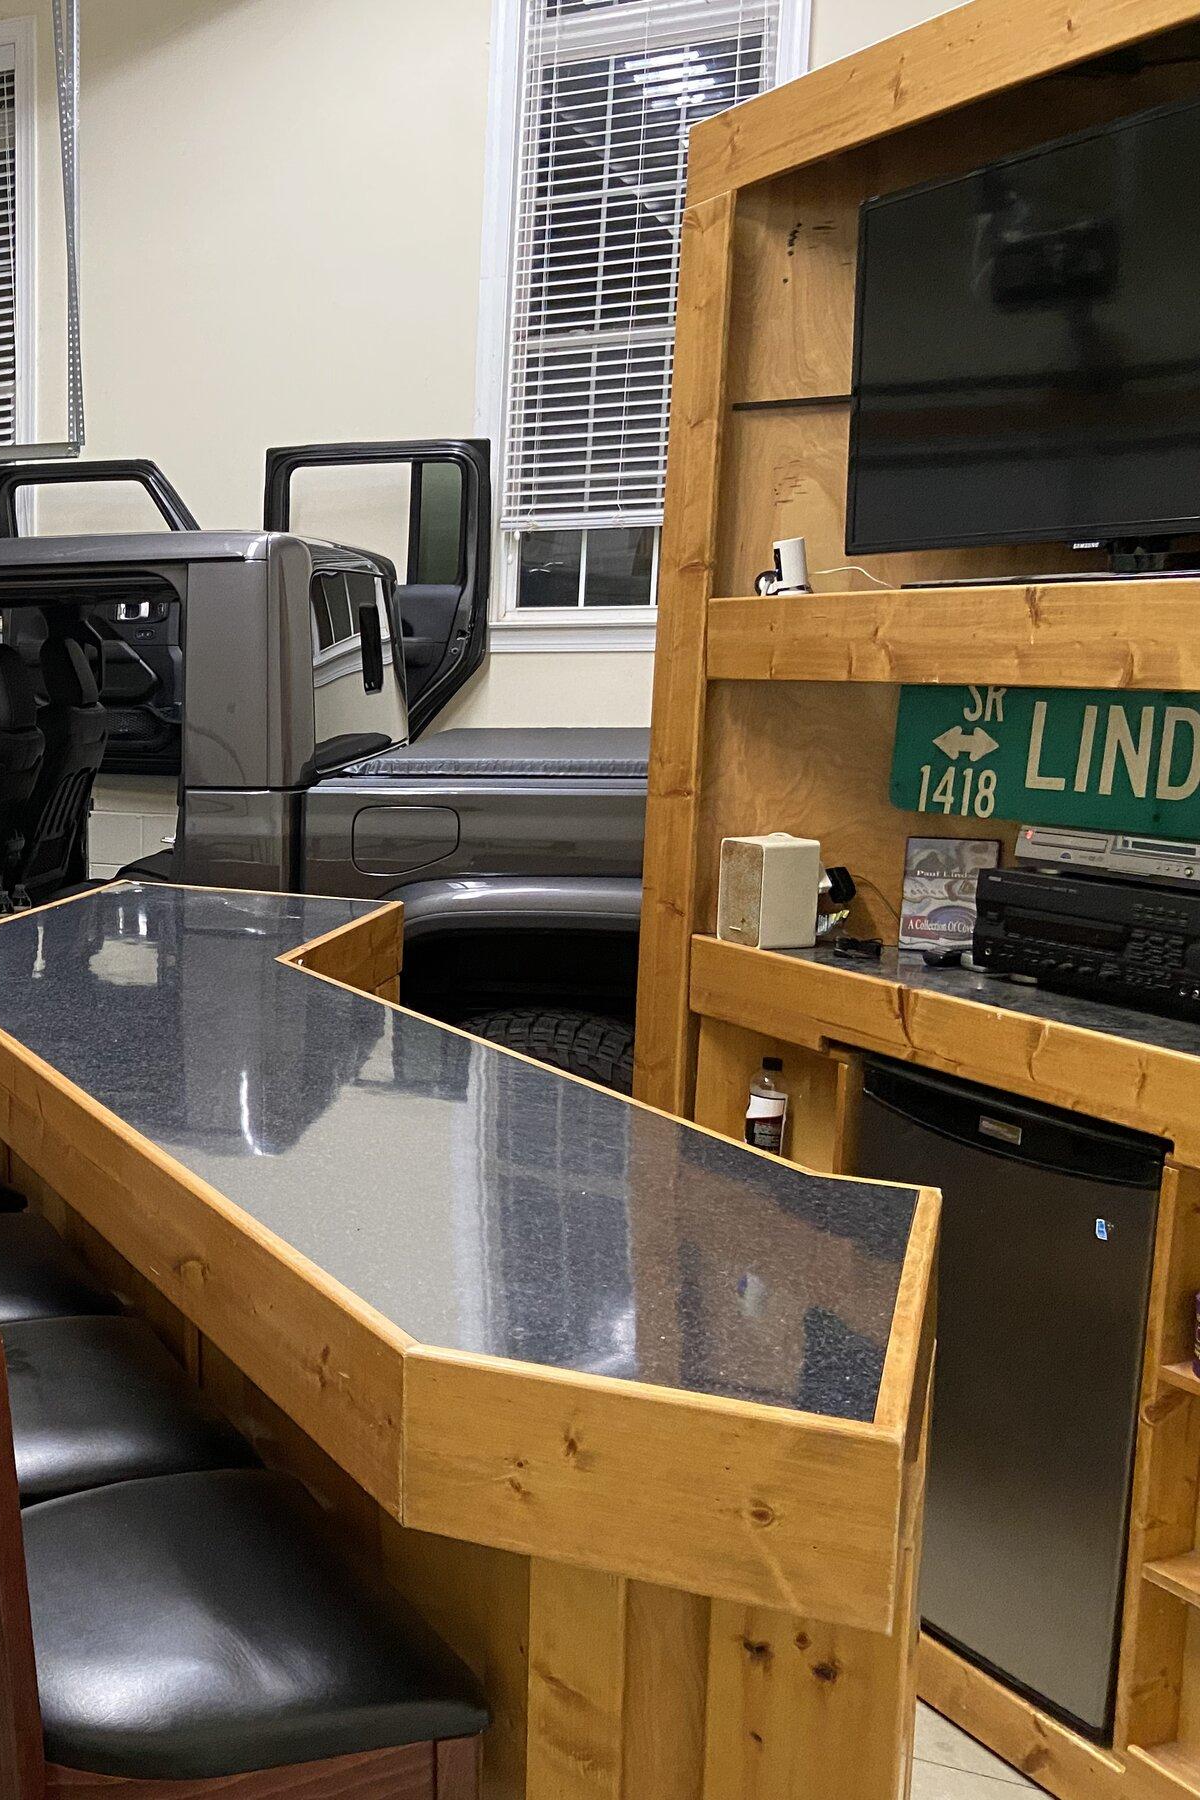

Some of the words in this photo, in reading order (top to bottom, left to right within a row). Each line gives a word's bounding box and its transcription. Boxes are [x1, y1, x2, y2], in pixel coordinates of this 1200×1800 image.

[963, 685, 1007, 721] SR
[918, 765, 997, 818] 1418
[916, 869, 940, 877] Paul
[907, 919, 914, 930] A
[914, 918, 947, 931] Collection
[947, 920, 958, 932] Of
